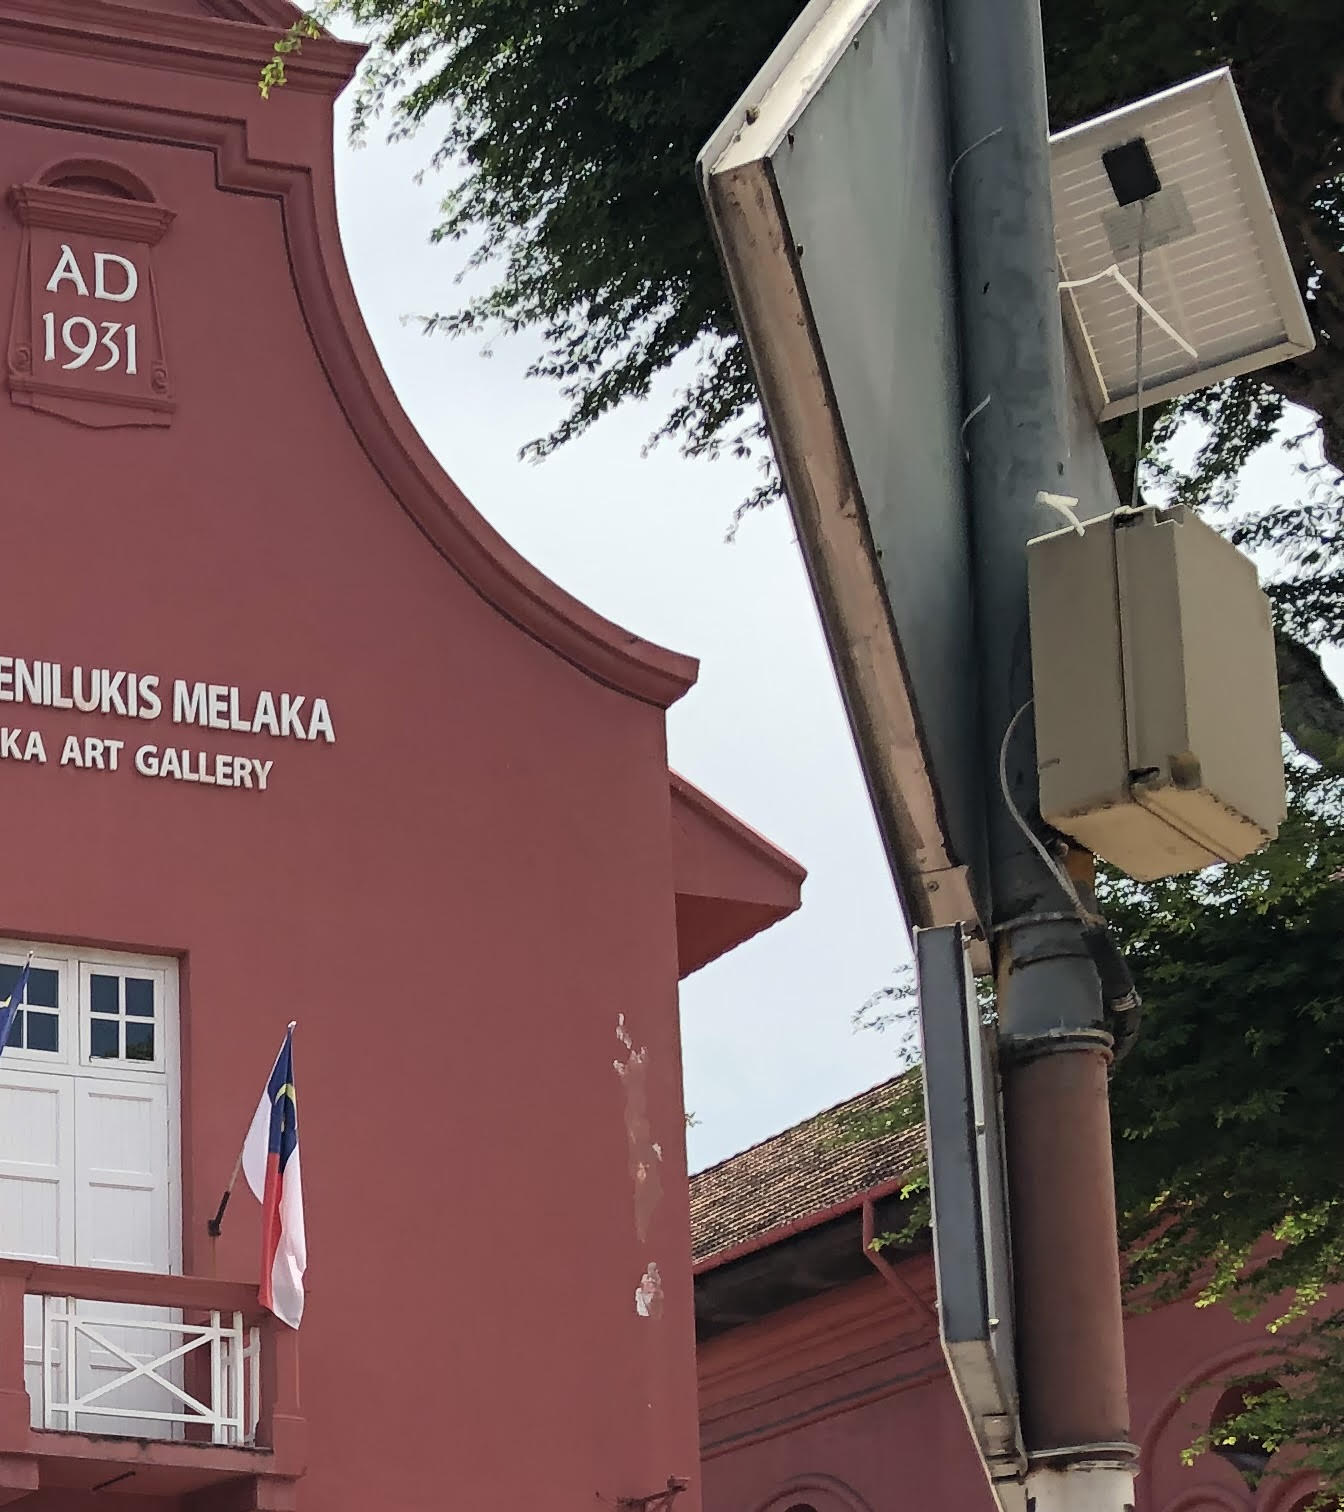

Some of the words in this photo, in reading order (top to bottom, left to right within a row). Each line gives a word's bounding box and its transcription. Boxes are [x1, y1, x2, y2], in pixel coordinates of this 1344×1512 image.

[45, 243, 139, 303] AD
[42, 311, 138, 376] 1931
[173, 678, 336, 743] MELAKA
[60, 735, 124, 771] ART
[135, 744, 274, 791] GALLERY
